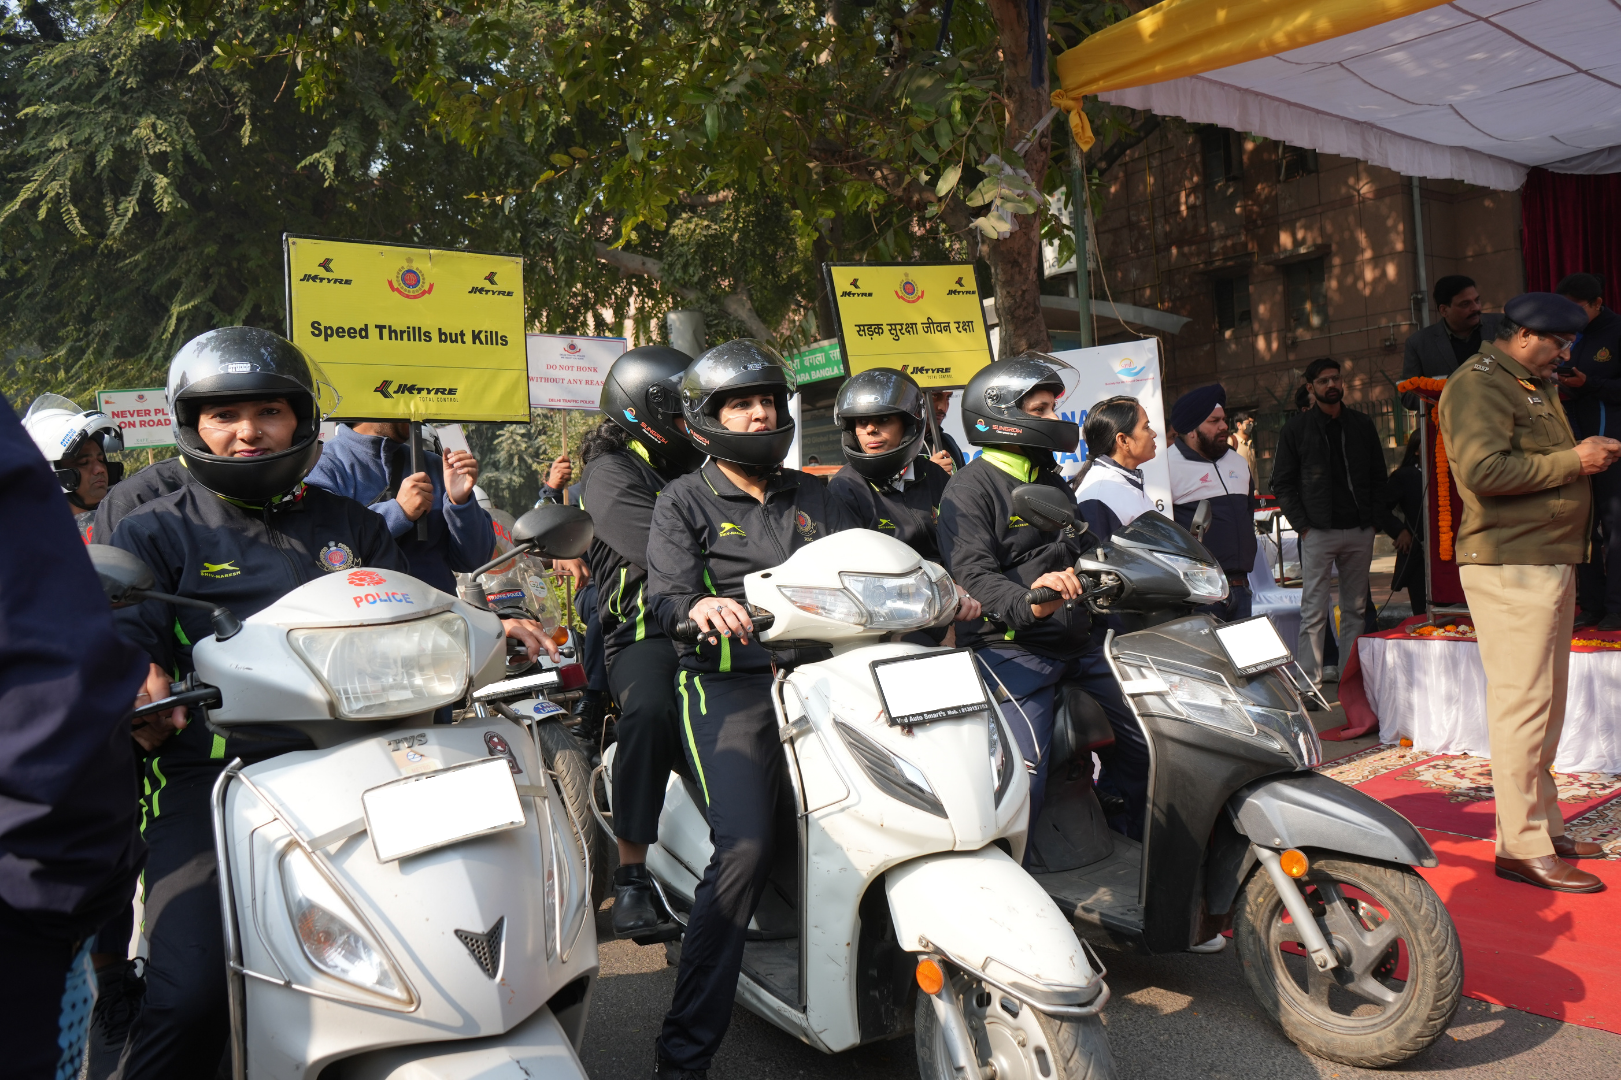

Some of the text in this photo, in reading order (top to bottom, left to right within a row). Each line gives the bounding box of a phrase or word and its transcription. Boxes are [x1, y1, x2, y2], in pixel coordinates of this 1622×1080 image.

[310, 320, 509, 347] Speed Thrills but Kills
[854, 317, 975, 342] सड़क सुरक्षा जीवन रक्षा
[546, 363, 557, 371] DO
[558, 364, 575, 372] NOT
[796, 372, 811, 383] ARA
[811, 365, 839, 380] BANGLA
[528, 376, 604, 387] WITHOUT ANY REAS
[111, 407, 169, 419] NEVER PL
[119, 418, 172, 429] ON ROAD
[352, 590, 414, 609] POLICE
[909, 715, 924, 723] Auto
[386, 732, 429, 753] TVS
